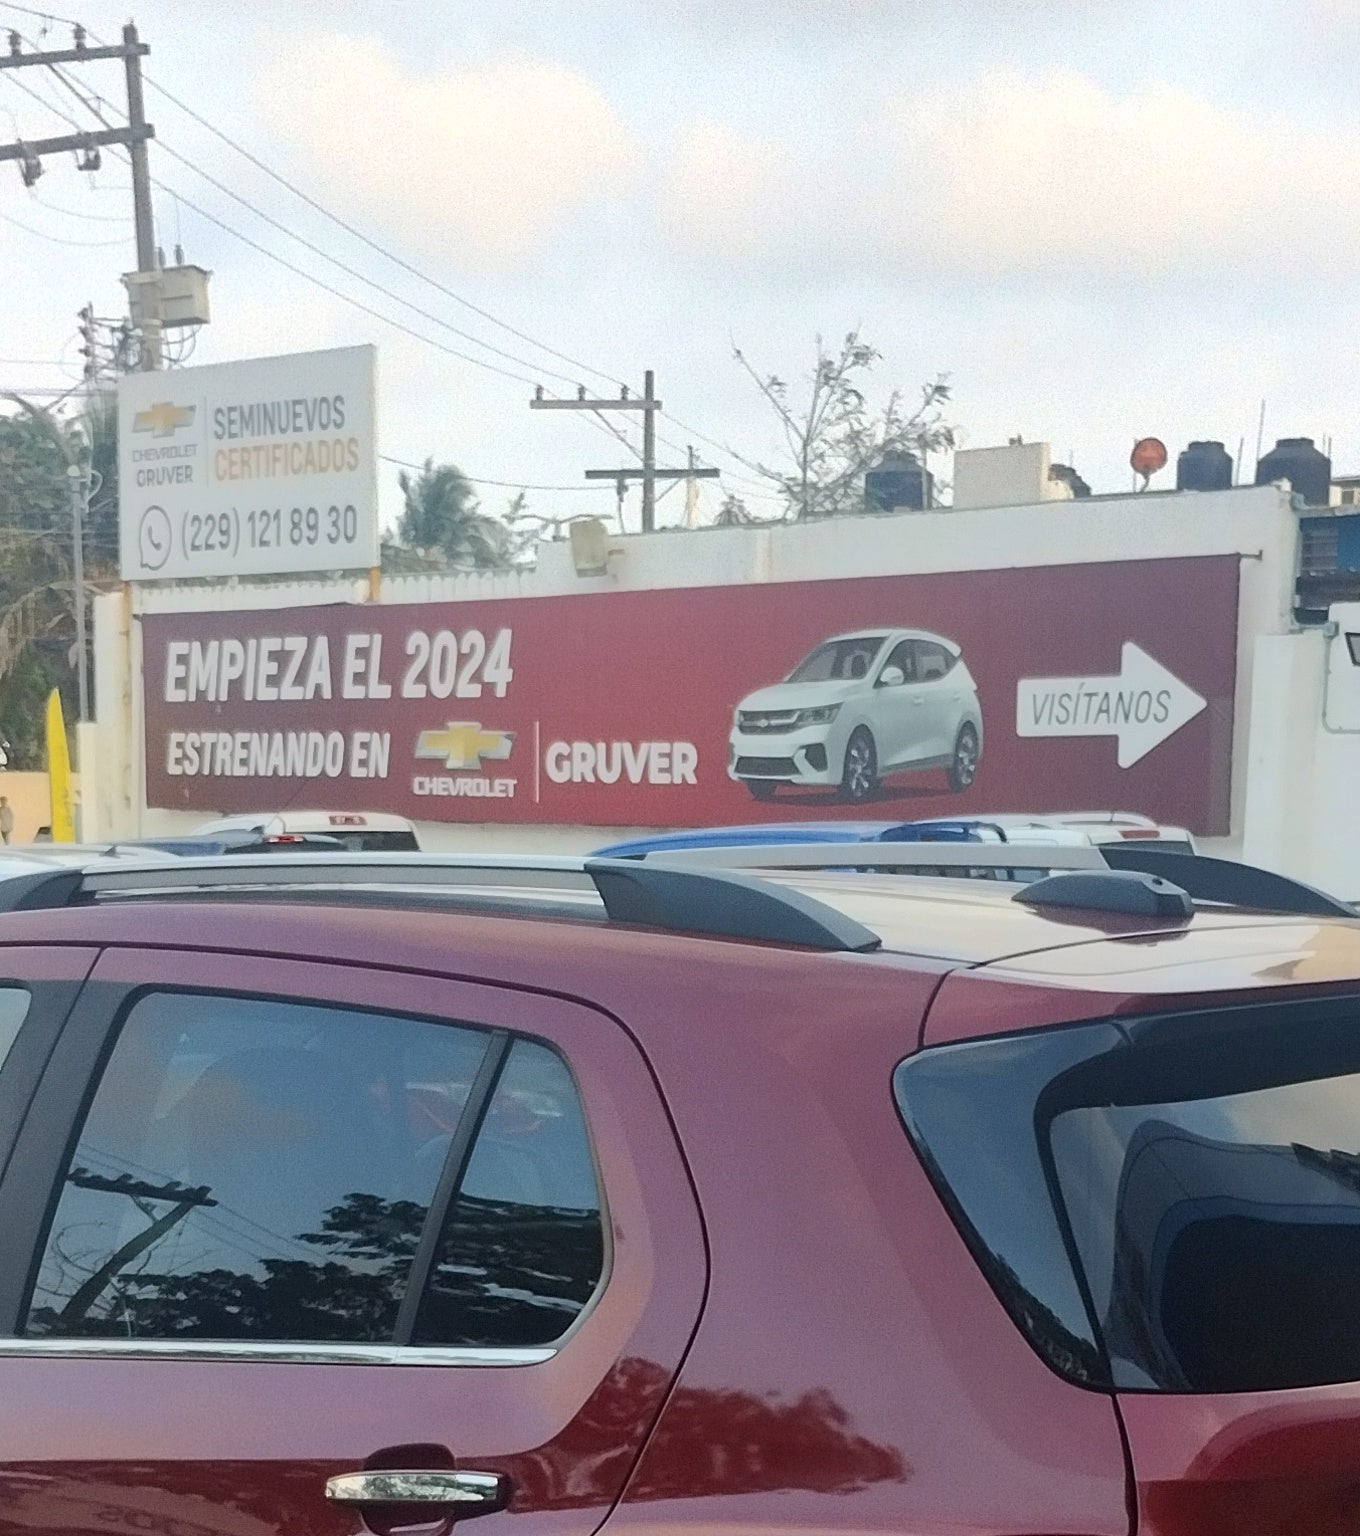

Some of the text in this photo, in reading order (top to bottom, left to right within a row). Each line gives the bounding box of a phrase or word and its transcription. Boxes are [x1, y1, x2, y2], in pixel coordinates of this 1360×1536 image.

[213, 395, 345, 440] SEMINUEVOS
[132, 444, 198, 462] CHEVROLET
[214, 437, 359, 481] CERTIFICADOS
[136, 465, 194, 488] GRUVER
[181, 504, 358, 560] (229) 121 89 30
[165, 627, 513, 702] EMPIEZA EL 2024
[1032, 682, 1171, 726] VISÍTANOS
[166, 731, 391, 779] ESTRENANDO EN
[545, 741, 698, 785] GRUVER
[412, 776, 517, 798] CHEVROLET
